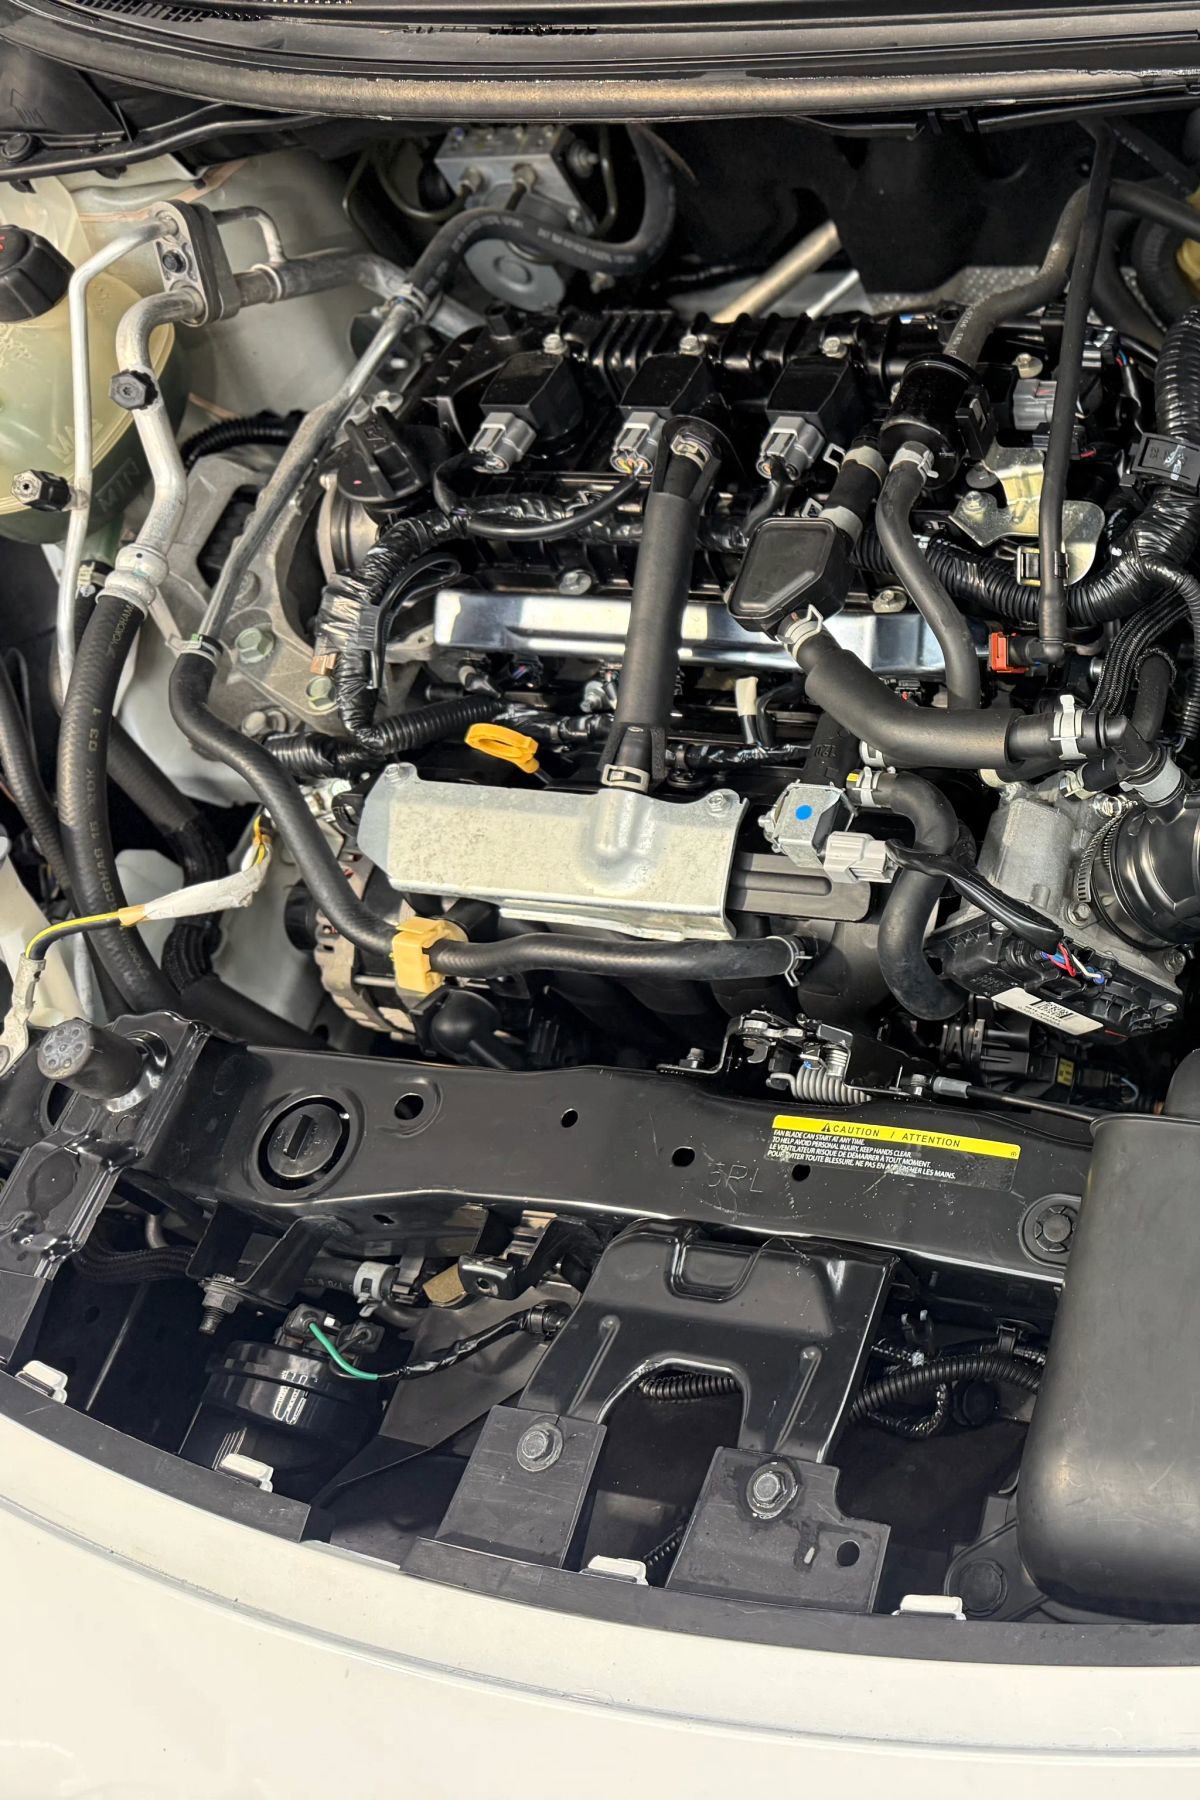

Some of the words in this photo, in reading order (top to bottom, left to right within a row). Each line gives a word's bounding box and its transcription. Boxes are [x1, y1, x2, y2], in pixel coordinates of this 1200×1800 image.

[833, 1124, 880, 1137] CAUTION
[902, 1133, 960, 1147] ATTENTION
[777, 1144, 815, 1154] VENTILATEUR
[816, 1148, 837, 1156] RISQUE
[902, 1158, 931, 1168] MOMENT.
[812, 1141, 839, 1149] PERSONAL
[873, 1147, 893, 1156] HANDS
[934, 1171, 956, 1179] MAINS.
